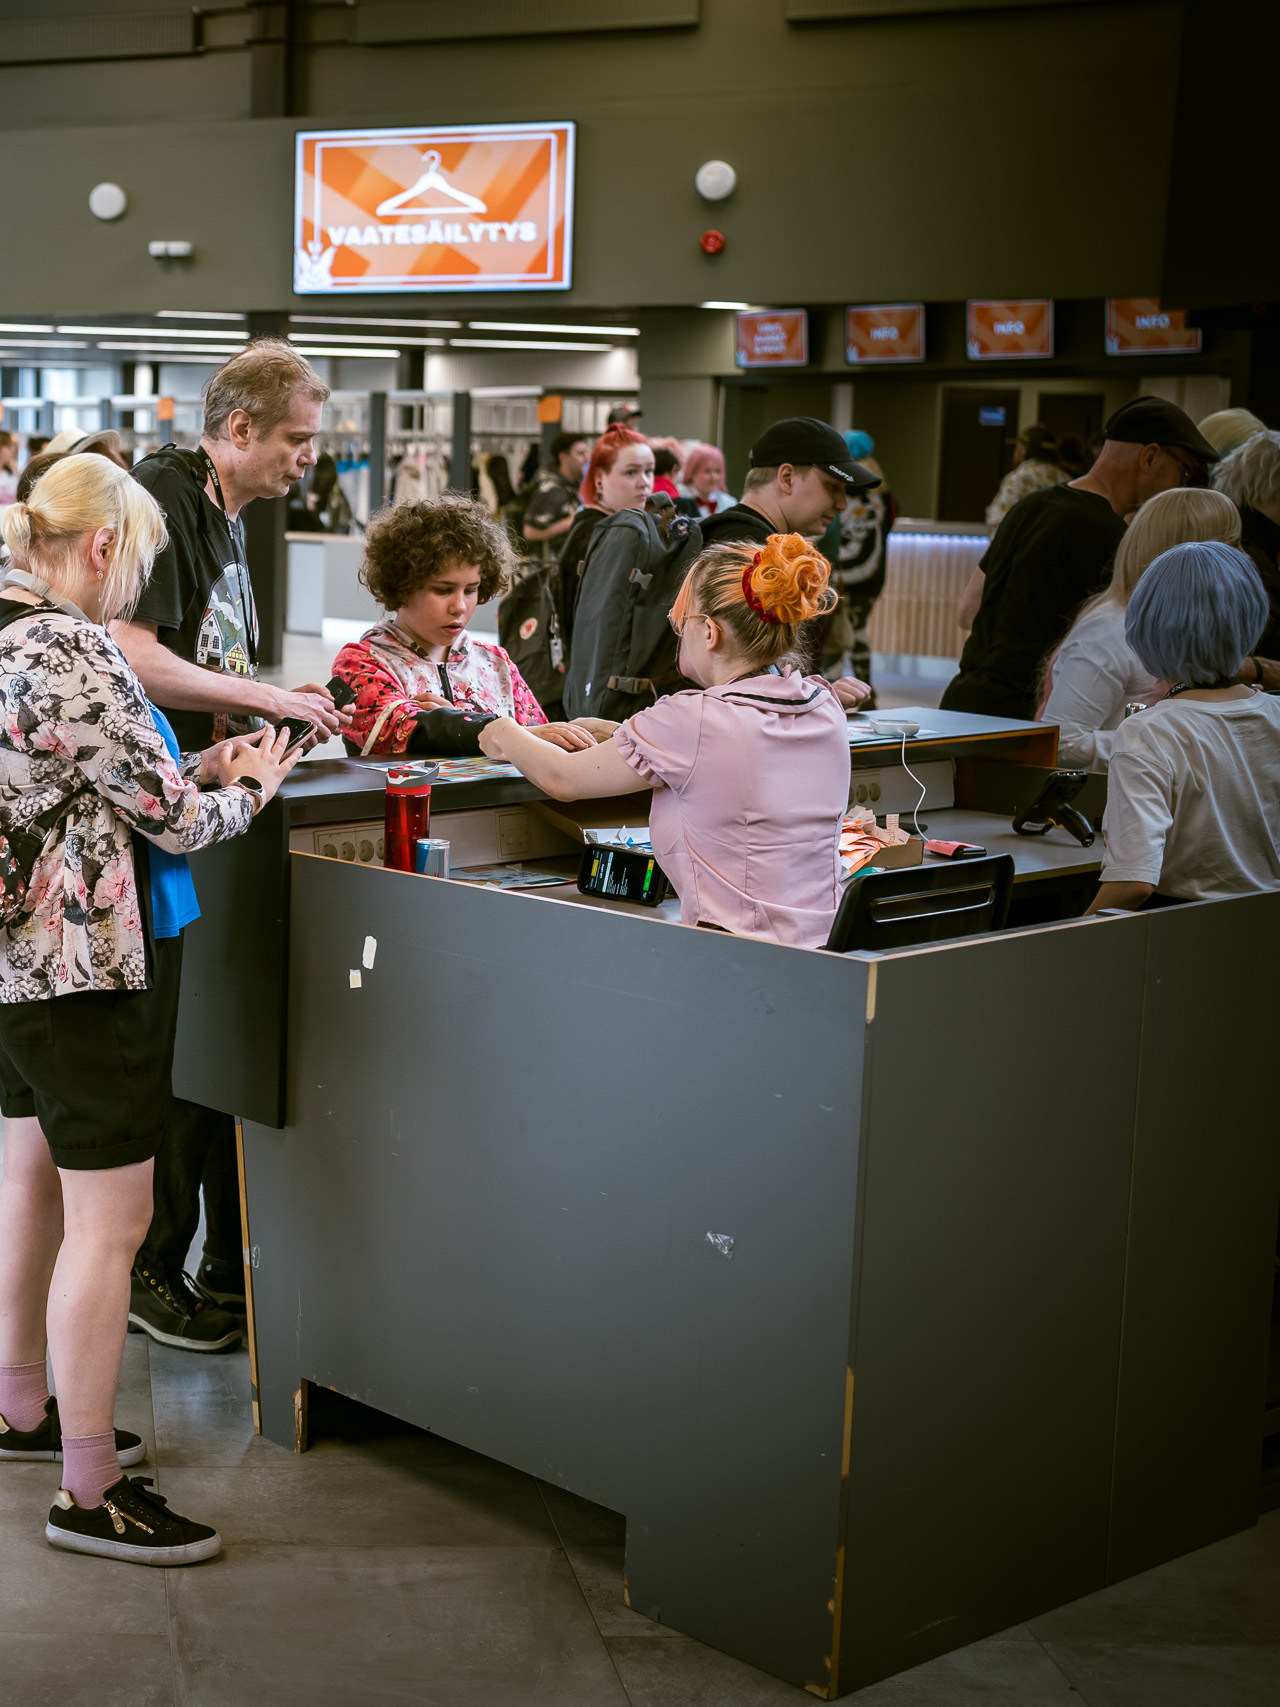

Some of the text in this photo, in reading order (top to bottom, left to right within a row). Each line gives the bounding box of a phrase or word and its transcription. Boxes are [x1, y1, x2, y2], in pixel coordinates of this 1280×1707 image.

[327, 220, 537, 246] VAATESÄILYTYS
[994, 320, 1025, 336] INFO
[1135, 313, 1170, 329] INFO
[870, 326, 900, 341] INFO
